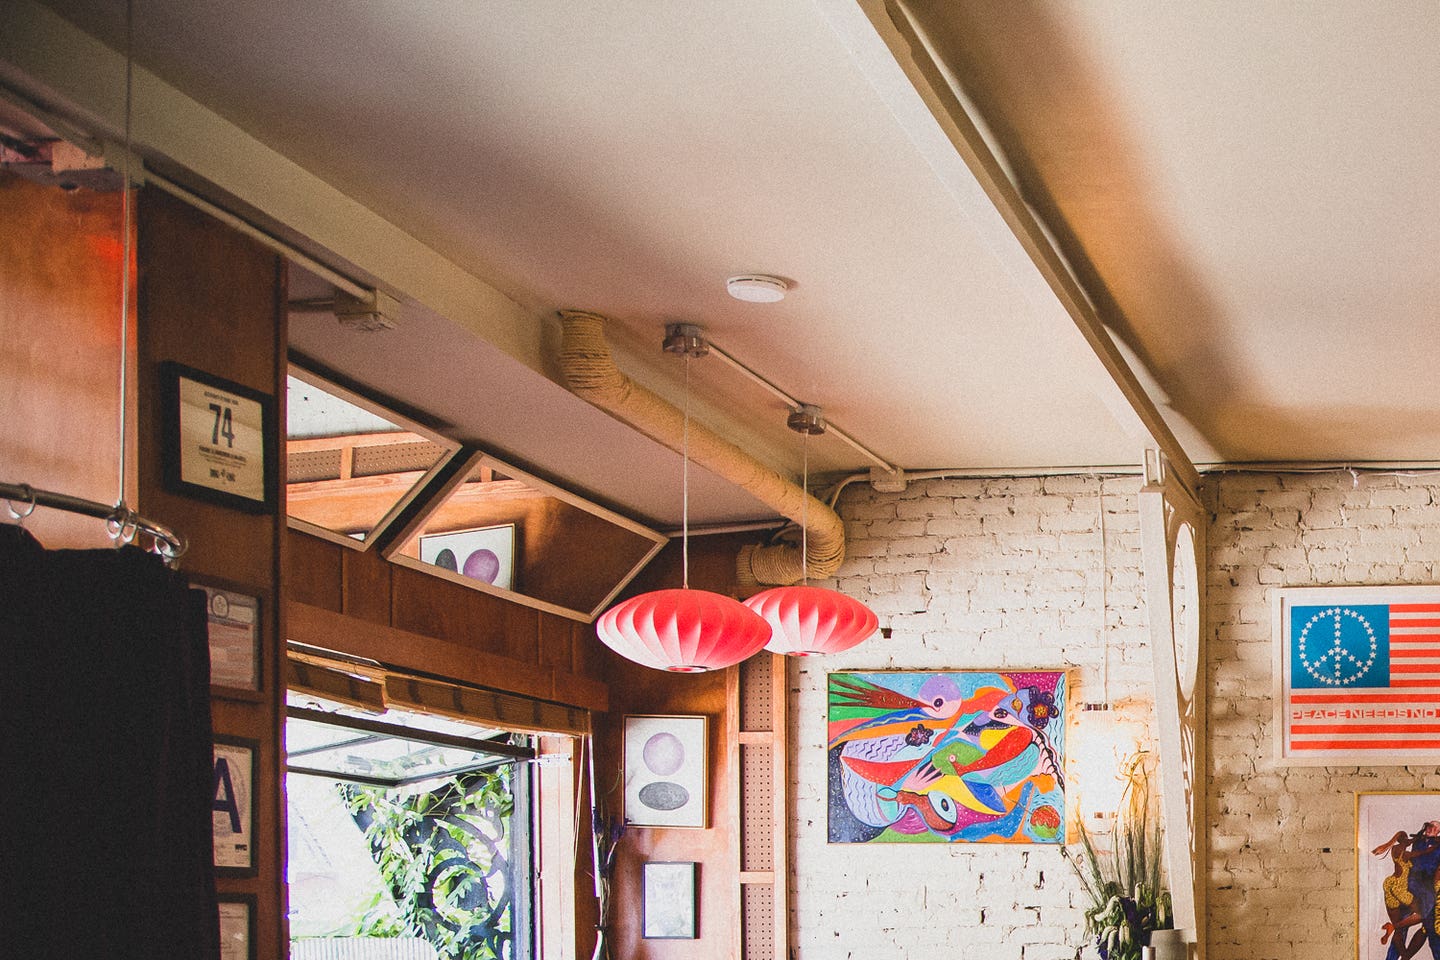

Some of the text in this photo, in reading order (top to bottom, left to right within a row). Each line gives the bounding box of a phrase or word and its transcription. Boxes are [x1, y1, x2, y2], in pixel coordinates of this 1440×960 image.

[209, 403, 235, 448] 74
[1292, 708, 1347, 720] PEACE
[1349, 708, 1408, 719] NEEDS
[1410, 708, 1437, 719] NO
[212, 757, 242, 833] A
